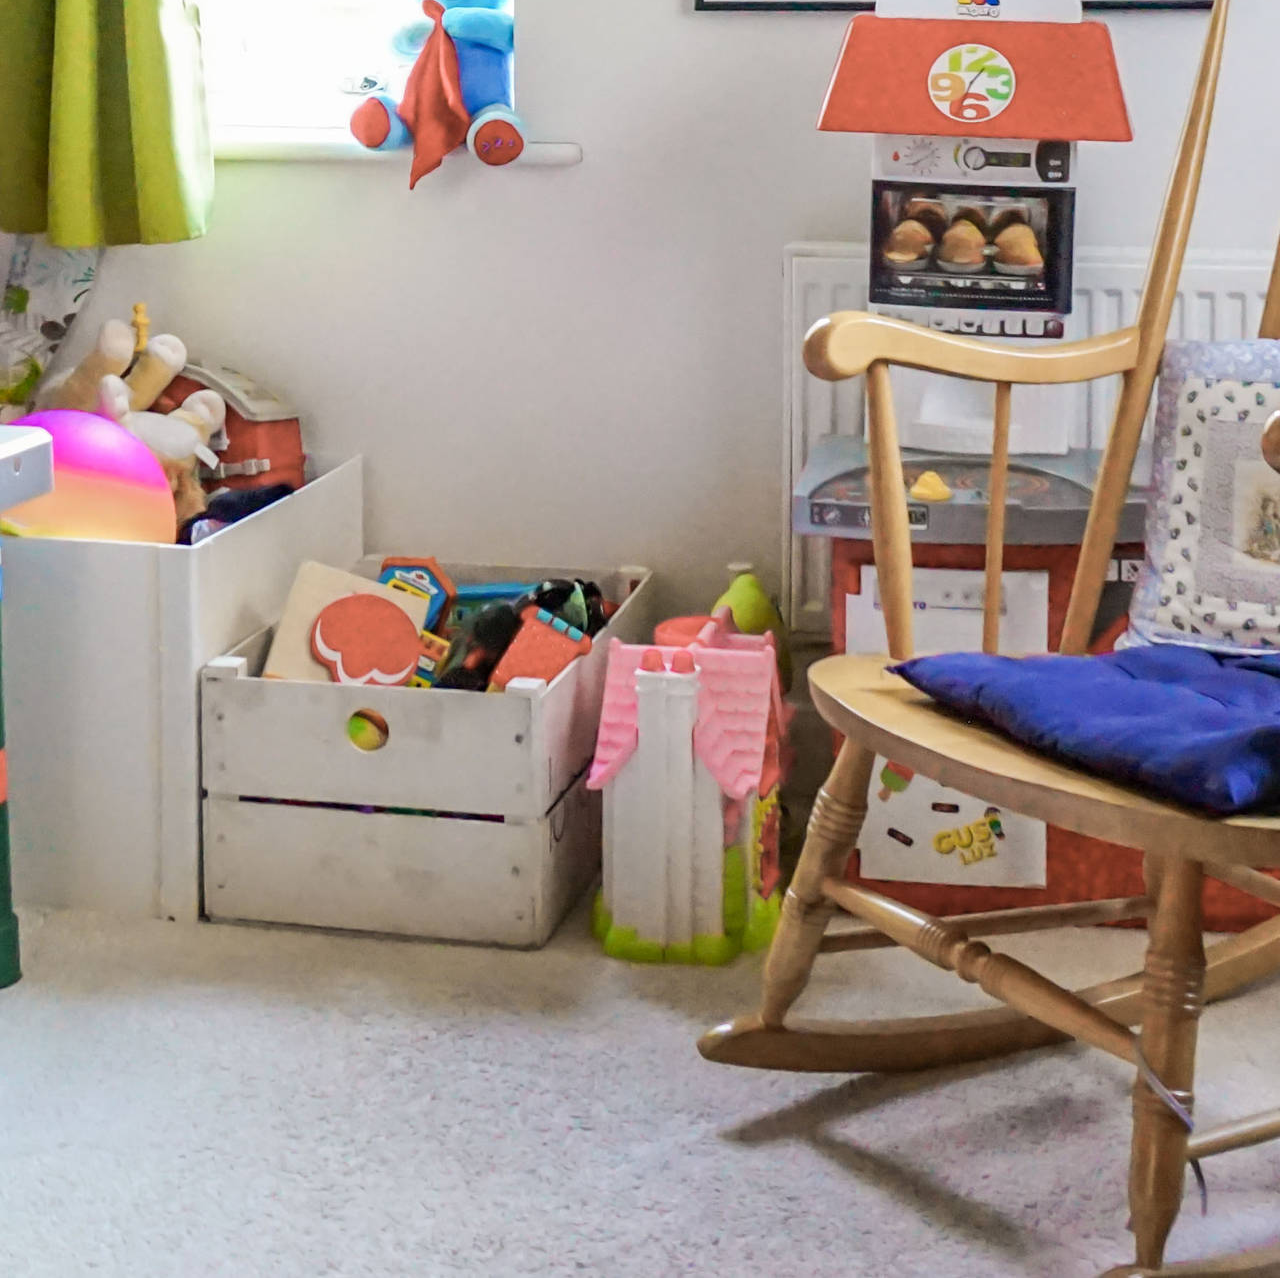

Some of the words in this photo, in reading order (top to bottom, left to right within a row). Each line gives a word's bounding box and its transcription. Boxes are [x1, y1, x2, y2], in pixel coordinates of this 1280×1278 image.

[948, 46, 1001, 73] 12
[930, 72, 966, 102] 9
[985, 67, 1013, 100] 3
[949, 92, 991, 121] 6
